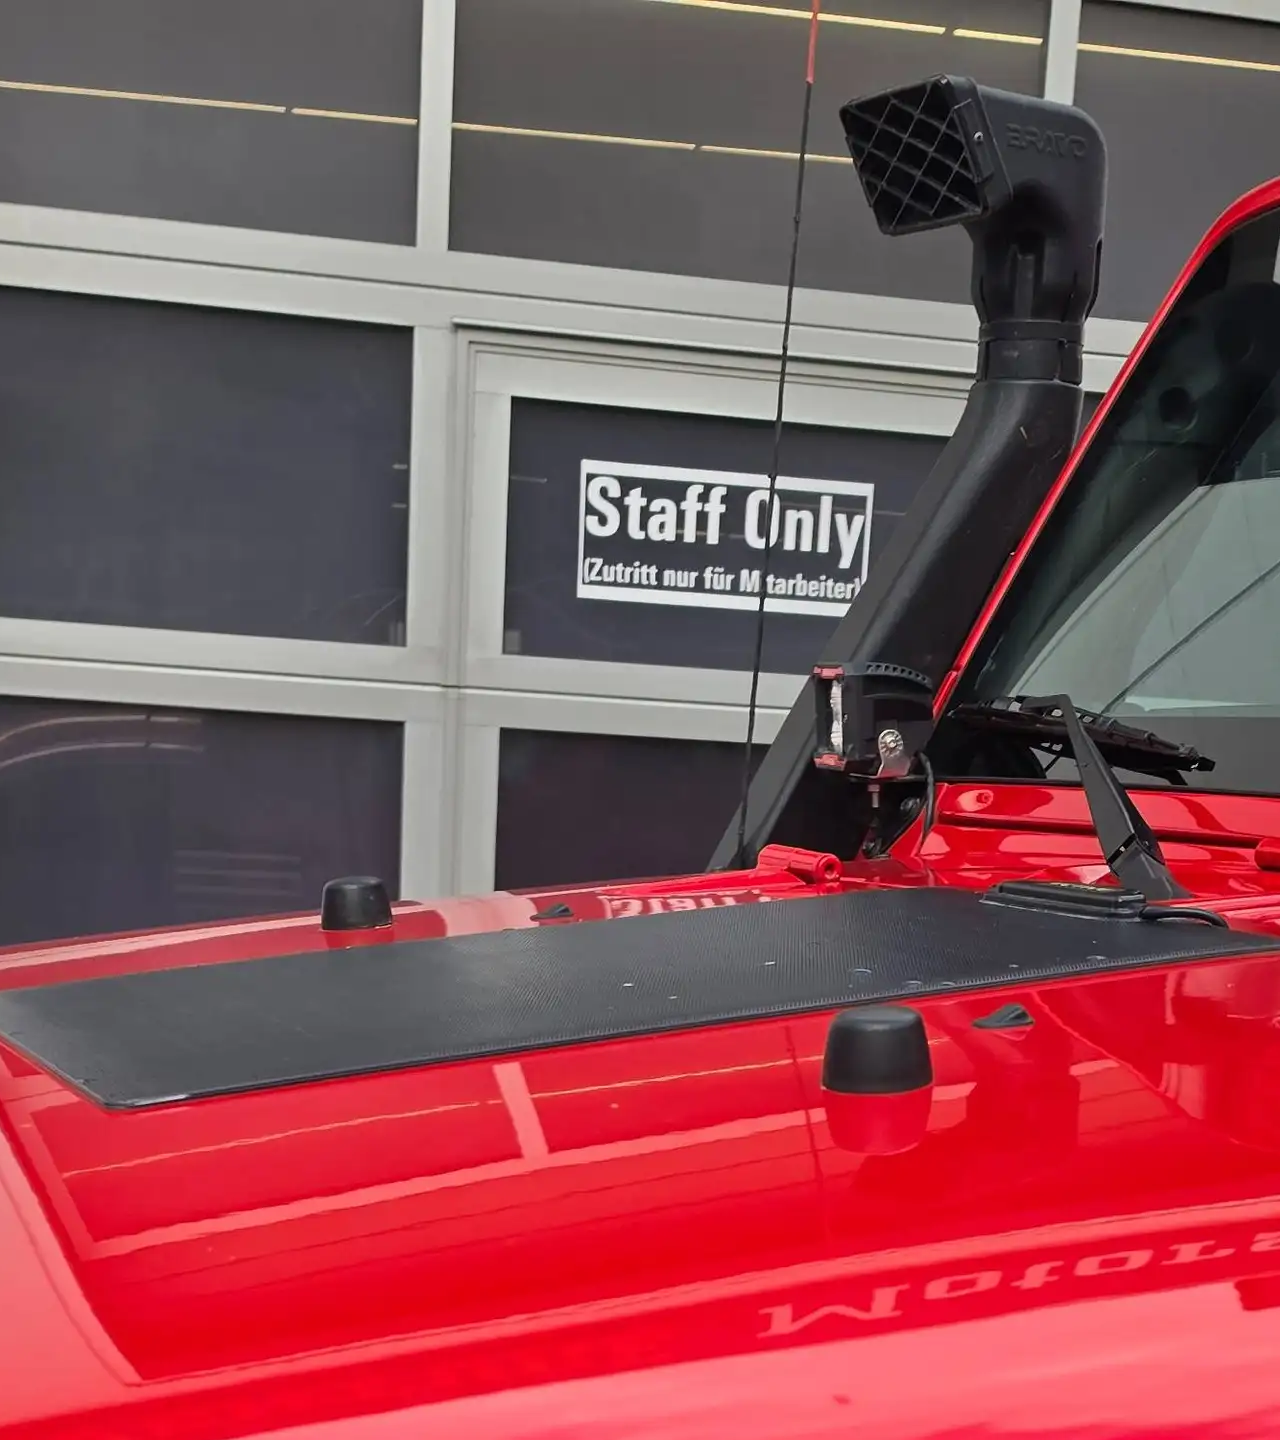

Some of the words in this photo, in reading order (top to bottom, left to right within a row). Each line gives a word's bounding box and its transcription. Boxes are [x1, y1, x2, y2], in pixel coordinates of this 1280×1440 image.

[585, 476, 728, 546] Staff
[744, 488, 865, 570] Only
[583, 557, 659, 586] (Zutritt
[662, 566, 697, 589] nur
[703, 566, 735, 592] für
[739, 568, 861, 600] Mtarbeiter)
